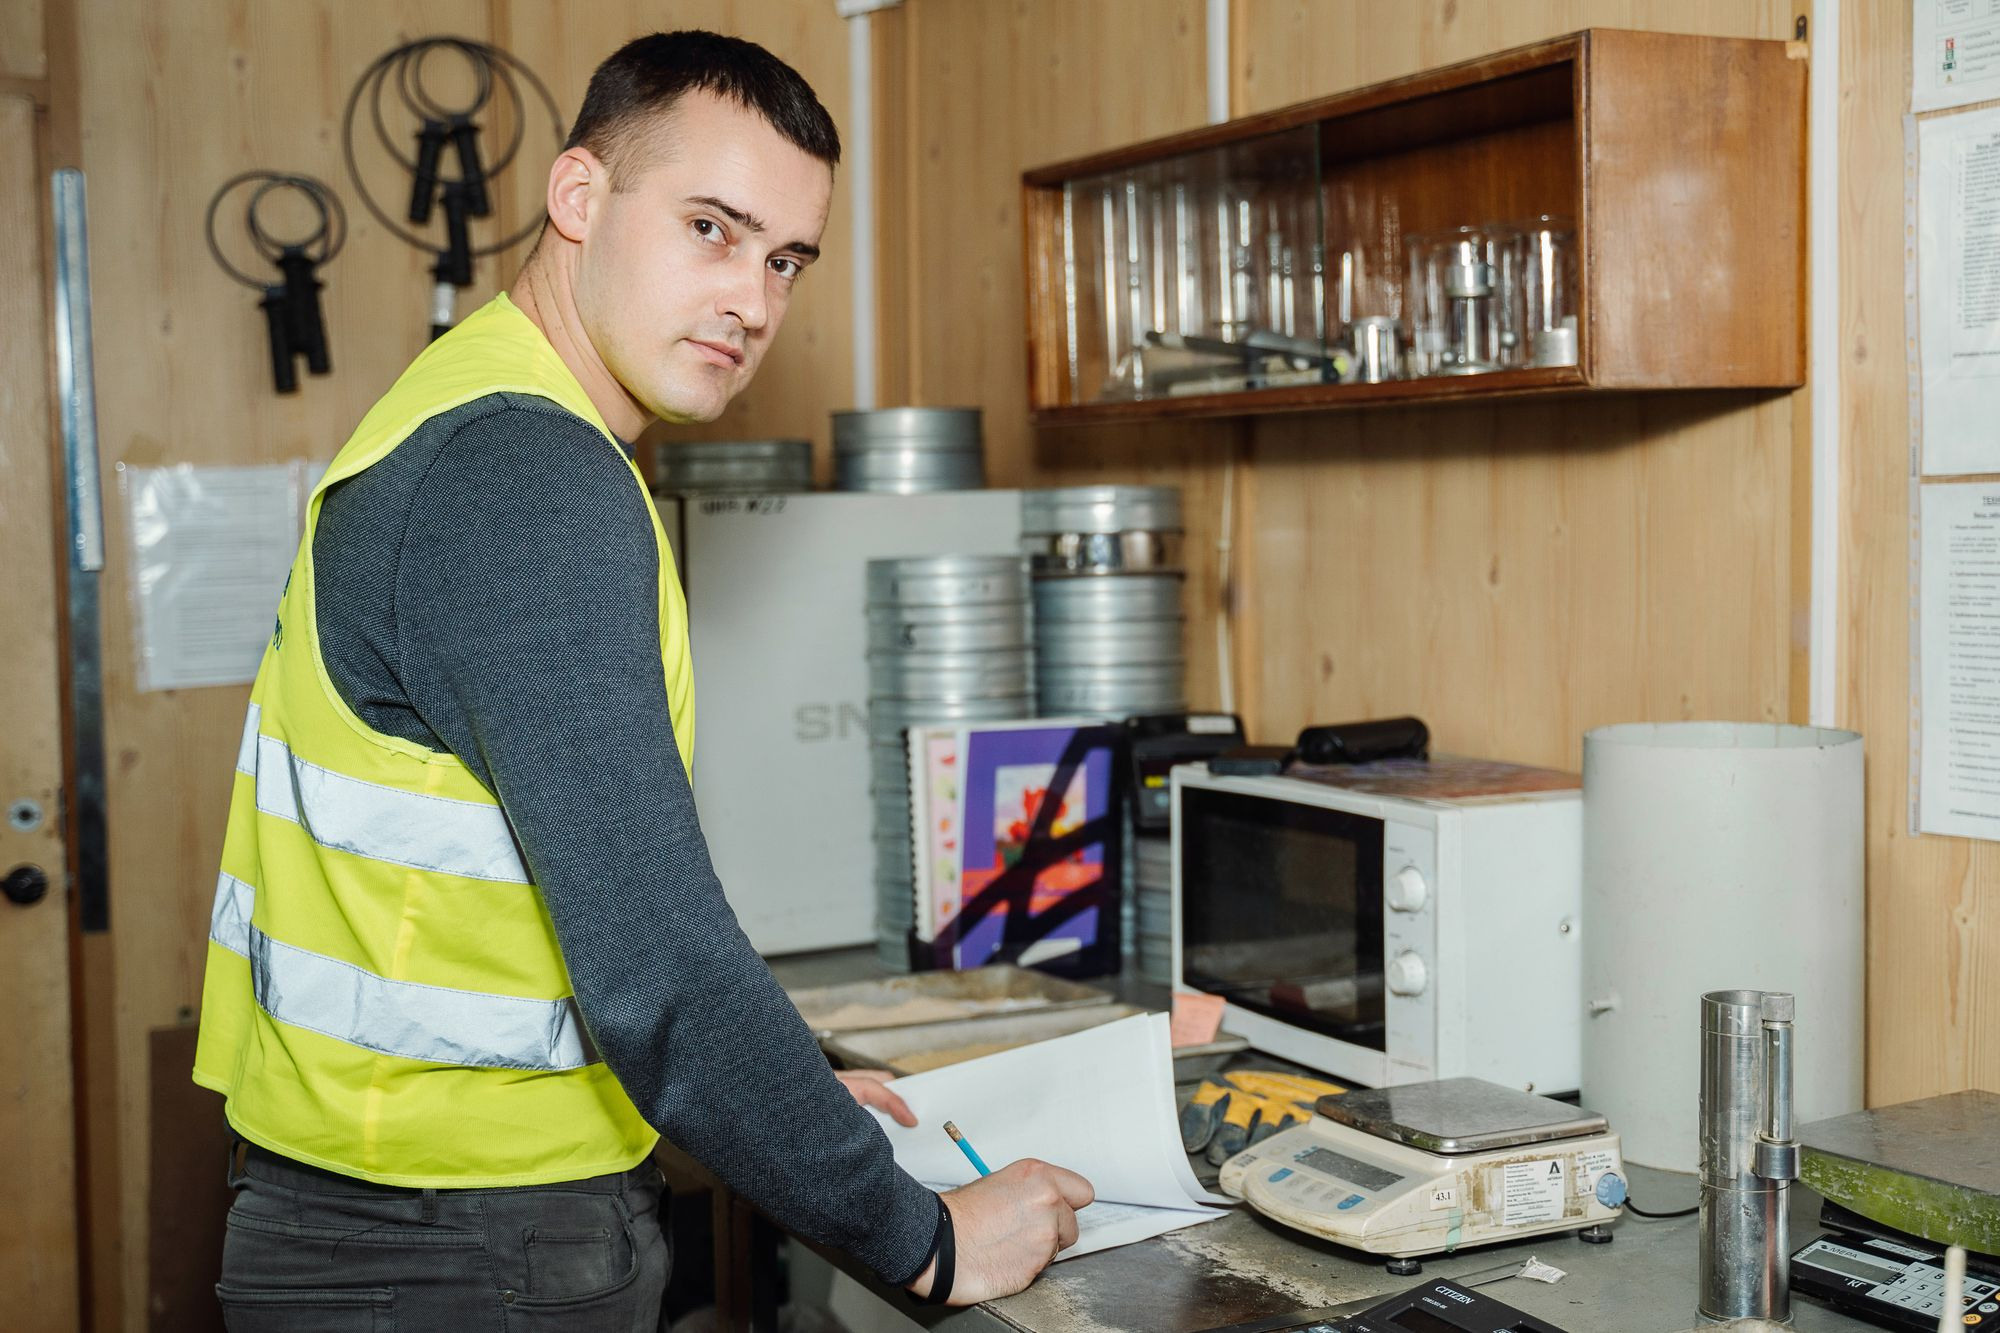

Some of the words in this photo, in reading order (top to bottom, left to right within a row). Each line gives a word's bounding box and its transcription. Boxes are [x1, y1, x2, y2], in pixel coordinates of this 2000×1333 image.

[1435, 1191, 1451, 1201] 43.1
[1830, 1247, 1858, 1259] МЕРА
[1435, 1285, 1476, 1305] CITIZEN
[1920, 1301, 1933, 1309] 3
